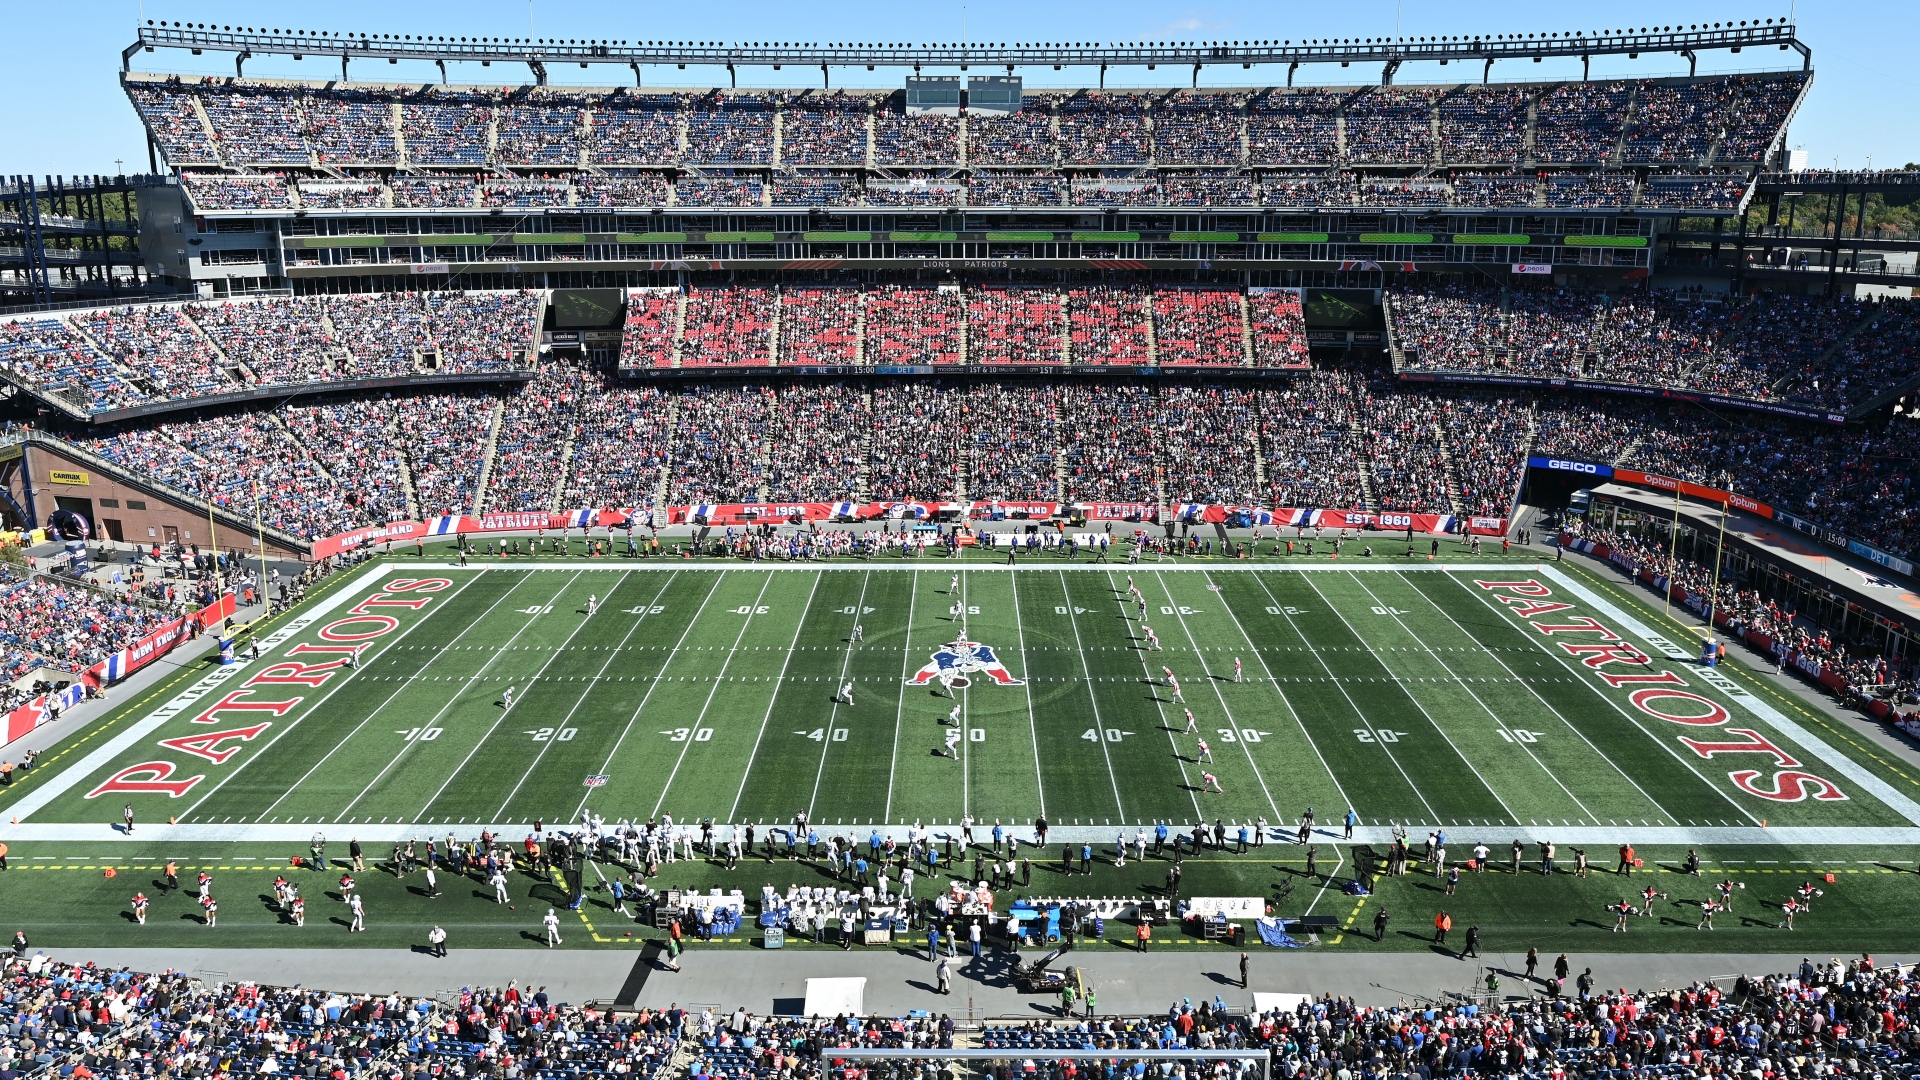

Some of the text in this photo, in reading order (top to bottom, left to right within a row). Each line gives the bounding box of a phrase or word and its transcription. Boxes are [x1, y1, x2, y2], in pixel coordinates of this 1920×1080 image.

[1548, 460, 1596, 474] GEICO
[1644, 474, 1676, 488] Optum
[1729, 494, 1758, 511] Optum
[743, 506, 772, 517] EST.
[478, 513, 549, 530] PATRIOTS
[1345, 513, 1411, 526] EST. 1960
[1792, 518, 1816, 536] NE 0
[341, 524, 414, 547] NEW ENGLAND
[1827, 531, 1846, 547] 15:00
[1870, 550, 1887, 564] DET
[525, 606, 554, 614] 10
[631, 606, 664, 614] 20
[737, 606, 770, 614] 30
[844, 606, 876, 614] 40
[1055, 606, 1086, 614] 40
[1160, 606, 1193, 614] 30
[1265, 606, 1300, 614] 20
[1370, 606, 1401, 614] 10
[132, 640, 154, 662] NEW
[1646, 638, 1683, 654] END
[152, 619, 312, 717] IT TAKES OF US
[1795, 653, 1821, 678] 1960
[84, 578, 454, 800] PATRIOTS
[1473, 579, 1851, 802] PATRIOTS
[404, 728, 444, 741] 10
[532, 728, 579, 741] 20
[670, 728, 714, 741] 30
[806, 728, 849, 742] 40
[945, 728, 986, 742] 50
[1081, 728, 1122, 742] 40
[1217, 728, 1261, 742] 30
[1353, 729, 1399, 742] 20
[1496, 729, 1538, 743] 10
